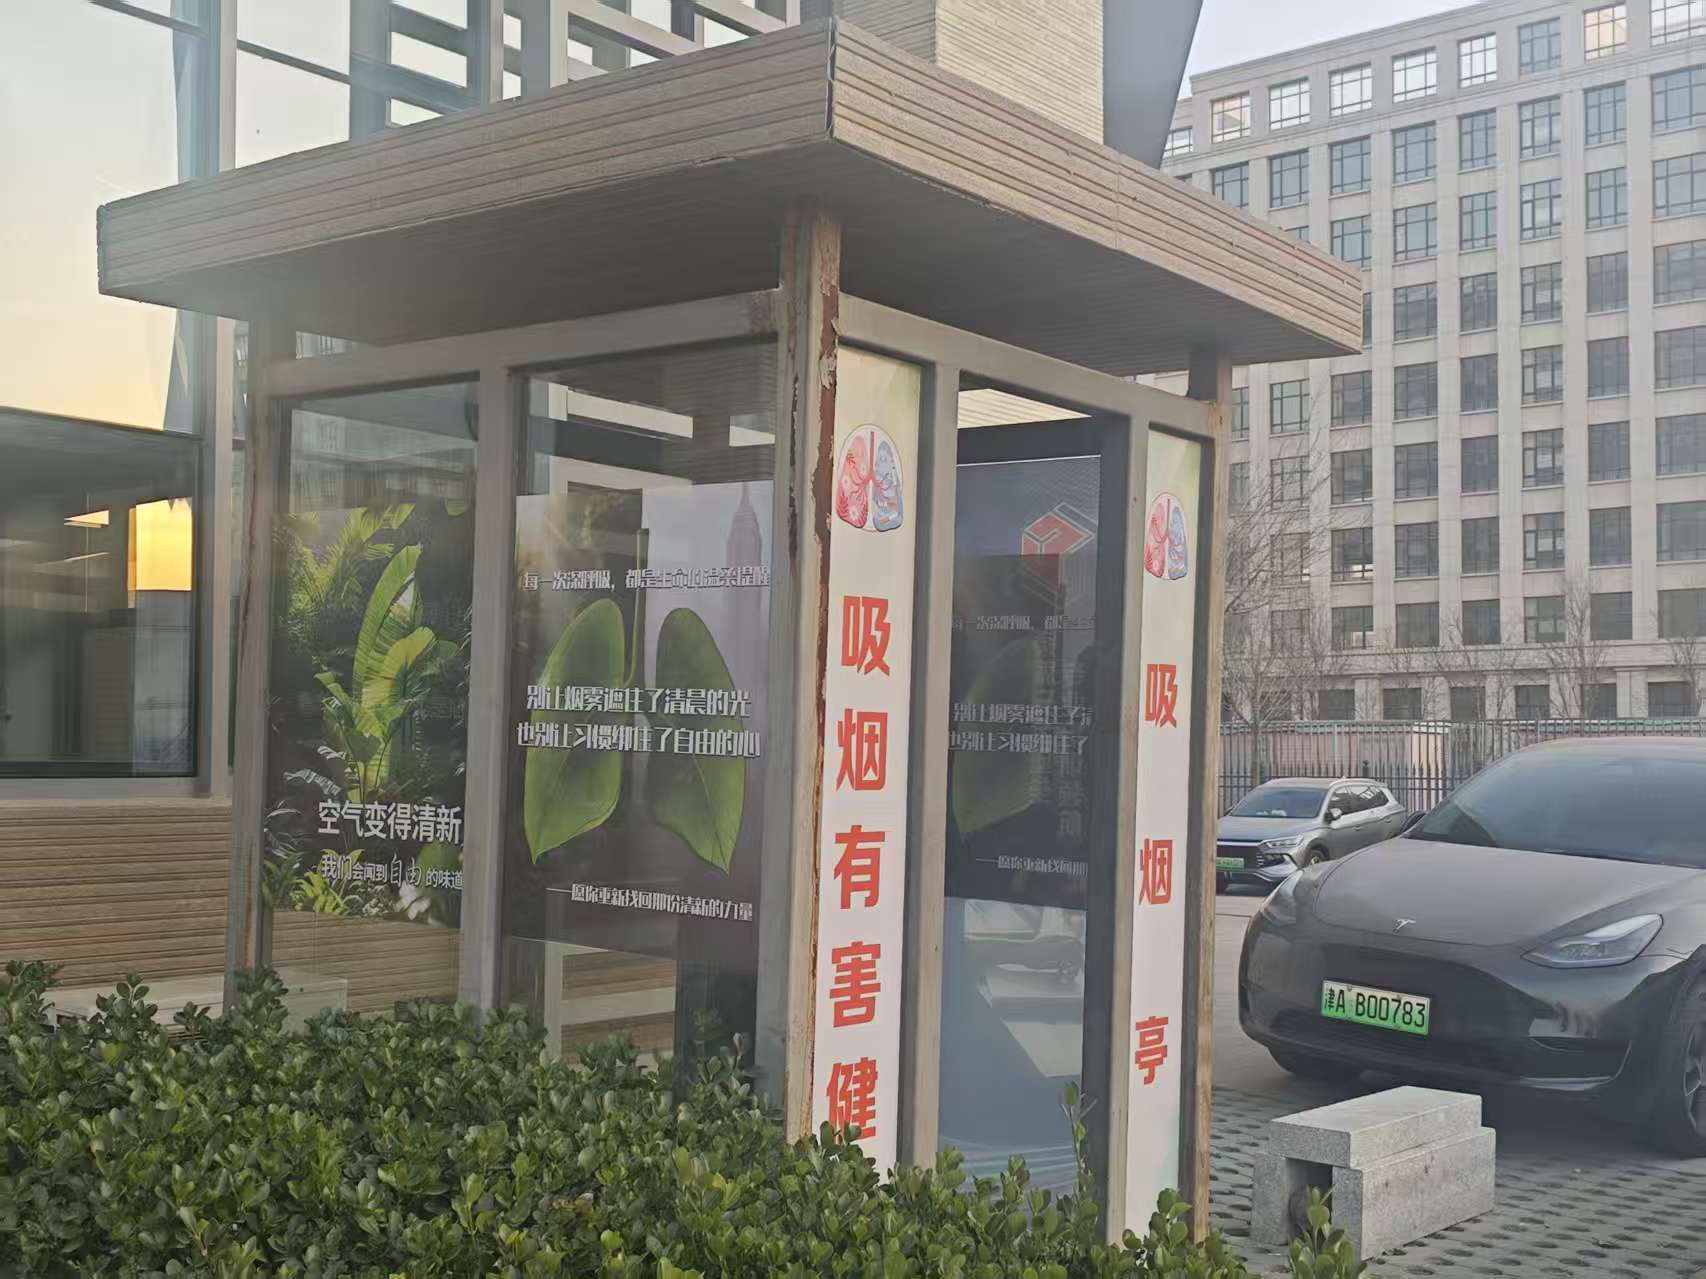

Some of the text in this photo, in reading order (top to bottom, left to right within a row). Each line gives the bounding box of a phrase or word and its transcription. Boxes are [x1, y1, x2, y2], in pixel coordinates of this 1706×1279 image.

[526, 684, 752, 718] 别让烟雾遮住了清晨的光
[516, 721, 761, 758] 也别让习惯绑住了自由的心
[1134, 663, 1179, 1085] 吸烟亭
[1355, 992, 1426, 1028] B00783
